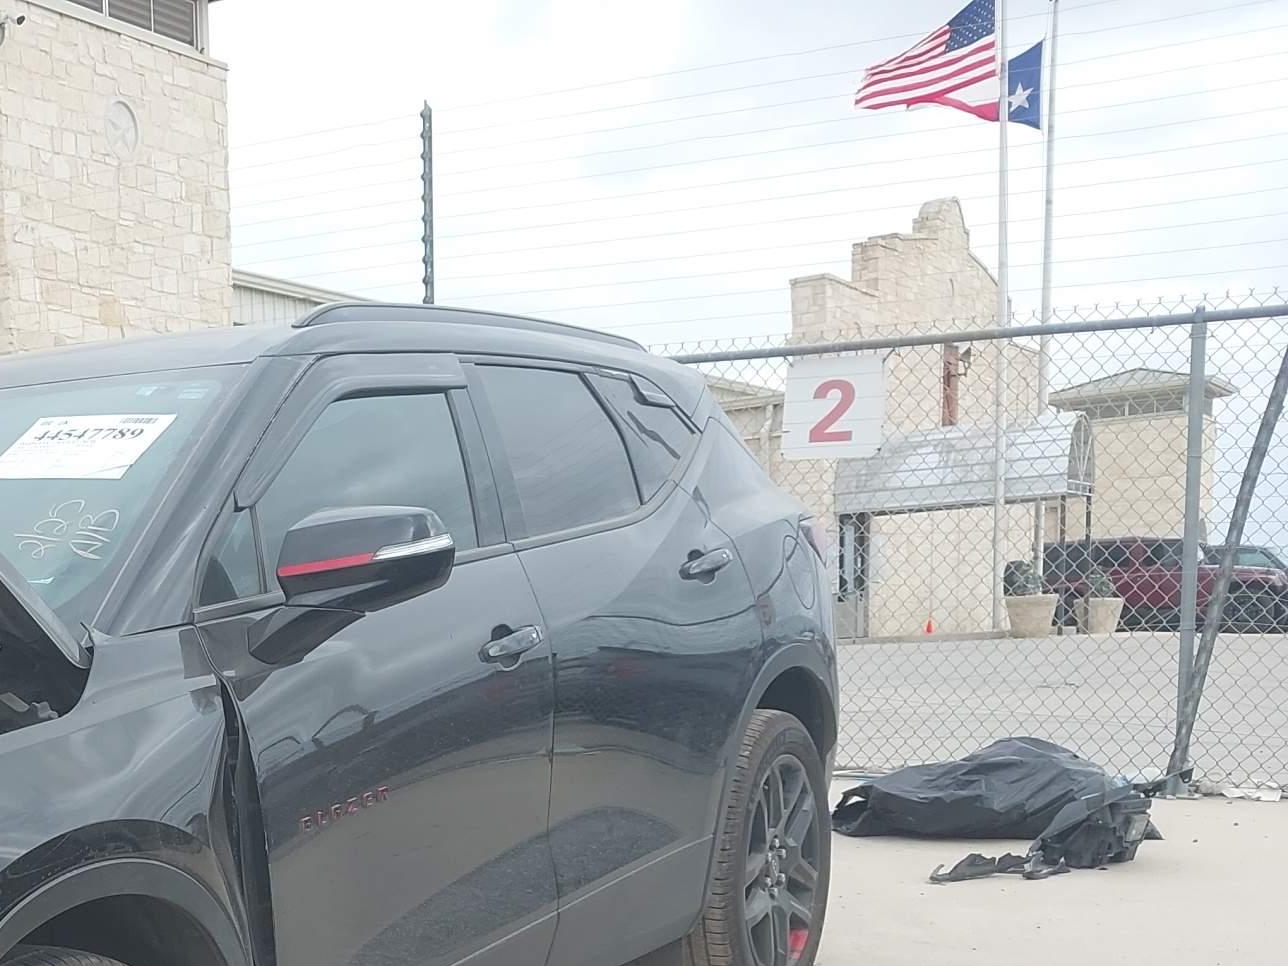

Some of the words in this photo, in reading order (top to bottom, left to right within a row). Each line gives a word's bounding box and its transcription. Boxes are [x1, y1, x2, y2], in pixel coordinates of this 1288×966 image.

[33, 427, 145, 442] 44547789
[808, 379, 856, 443] 2
[300, 785, 389, 833] BLAZER
